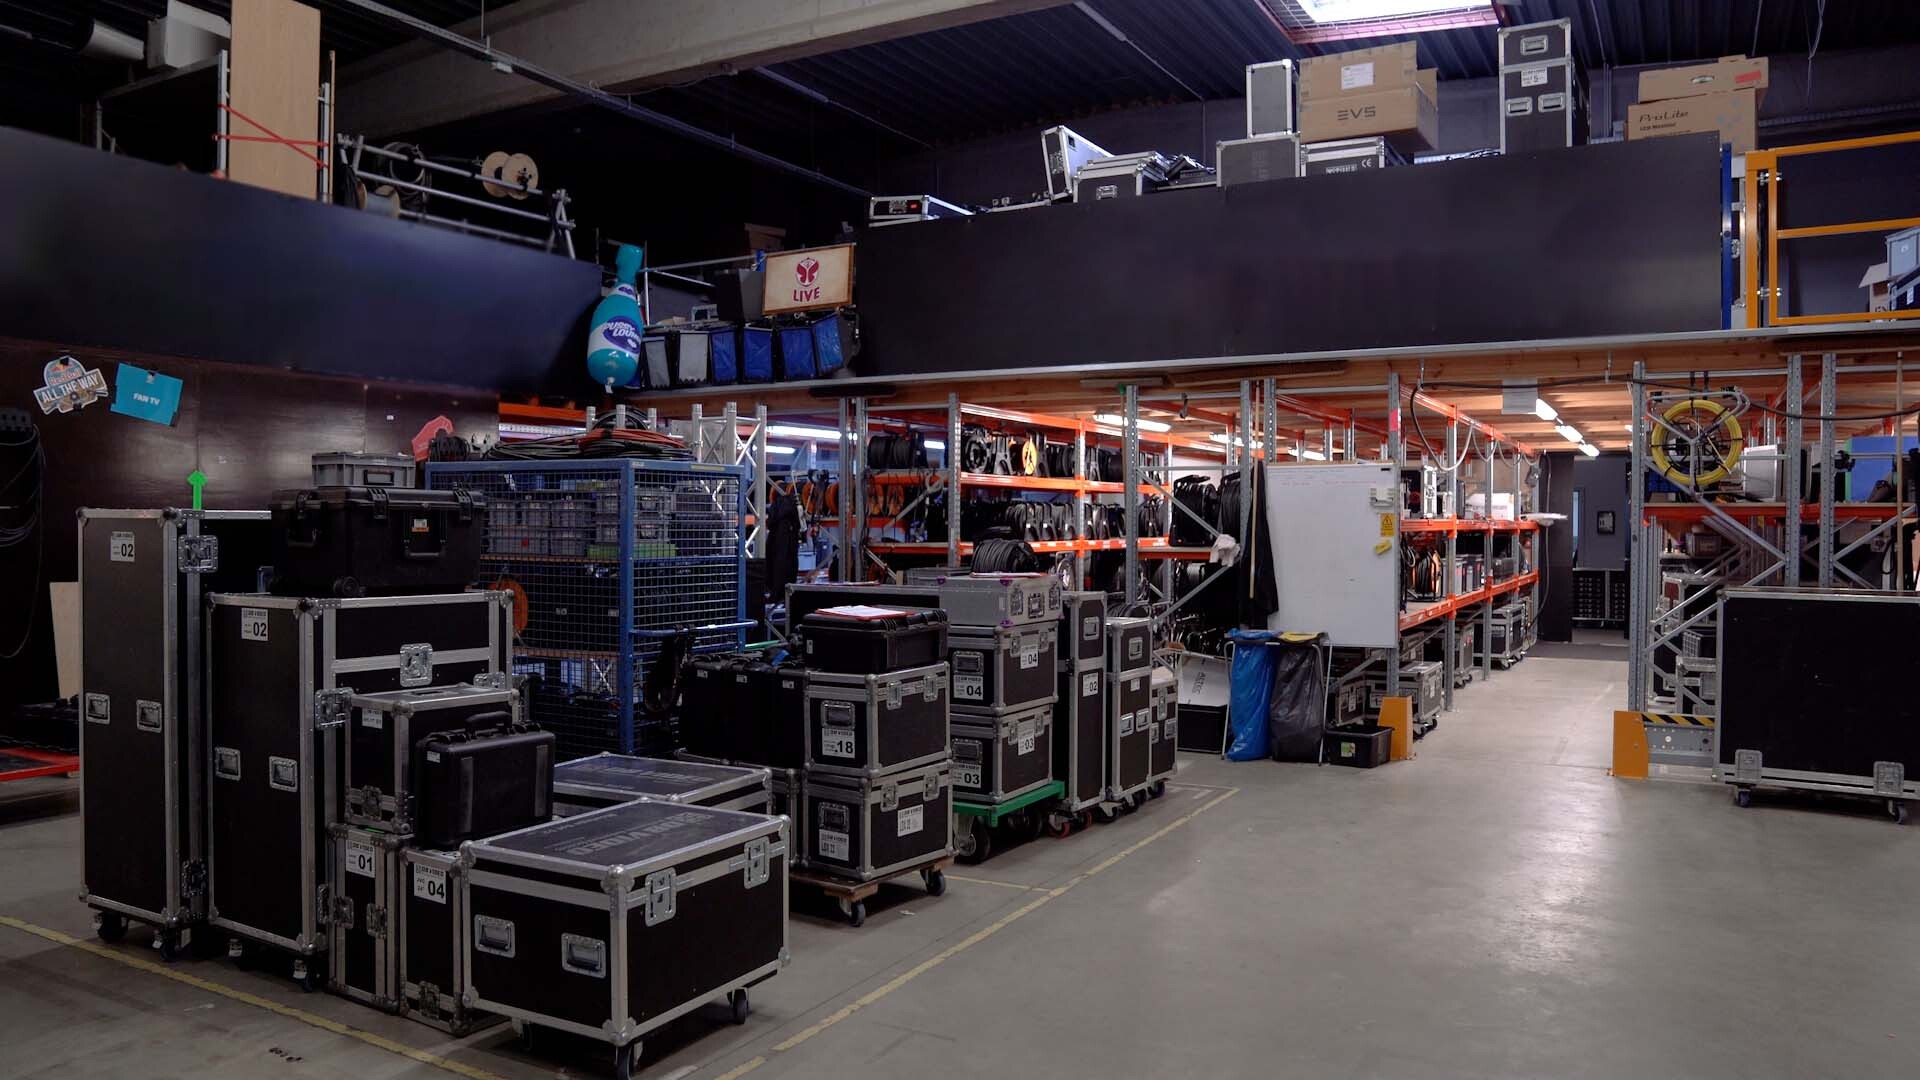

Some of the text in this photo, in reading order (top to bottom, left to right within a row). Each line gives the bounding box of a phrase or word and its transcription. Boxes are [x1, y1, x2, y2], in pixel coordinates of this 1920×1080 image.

[1337, 106, 1376, 121] EVS
[793, 286, 820, 302] LIVE
[41, 374, 100, 403] ALL THE WAY
[133, 392, 161, 406] FAN TV
[121, 543, 134, 557] 02
[253, 622, 267, 637] 02
[1028, 652, 1038, 665] 04
[966, 685, 982, 696] 04
[1089, 681, 1098, 692] 02
[1024, 738, 1034, 750] 03
[964, 773, 980, 785] 03
[358, 854, 373, 872] 01
[428, 880, 446, 899] 04
